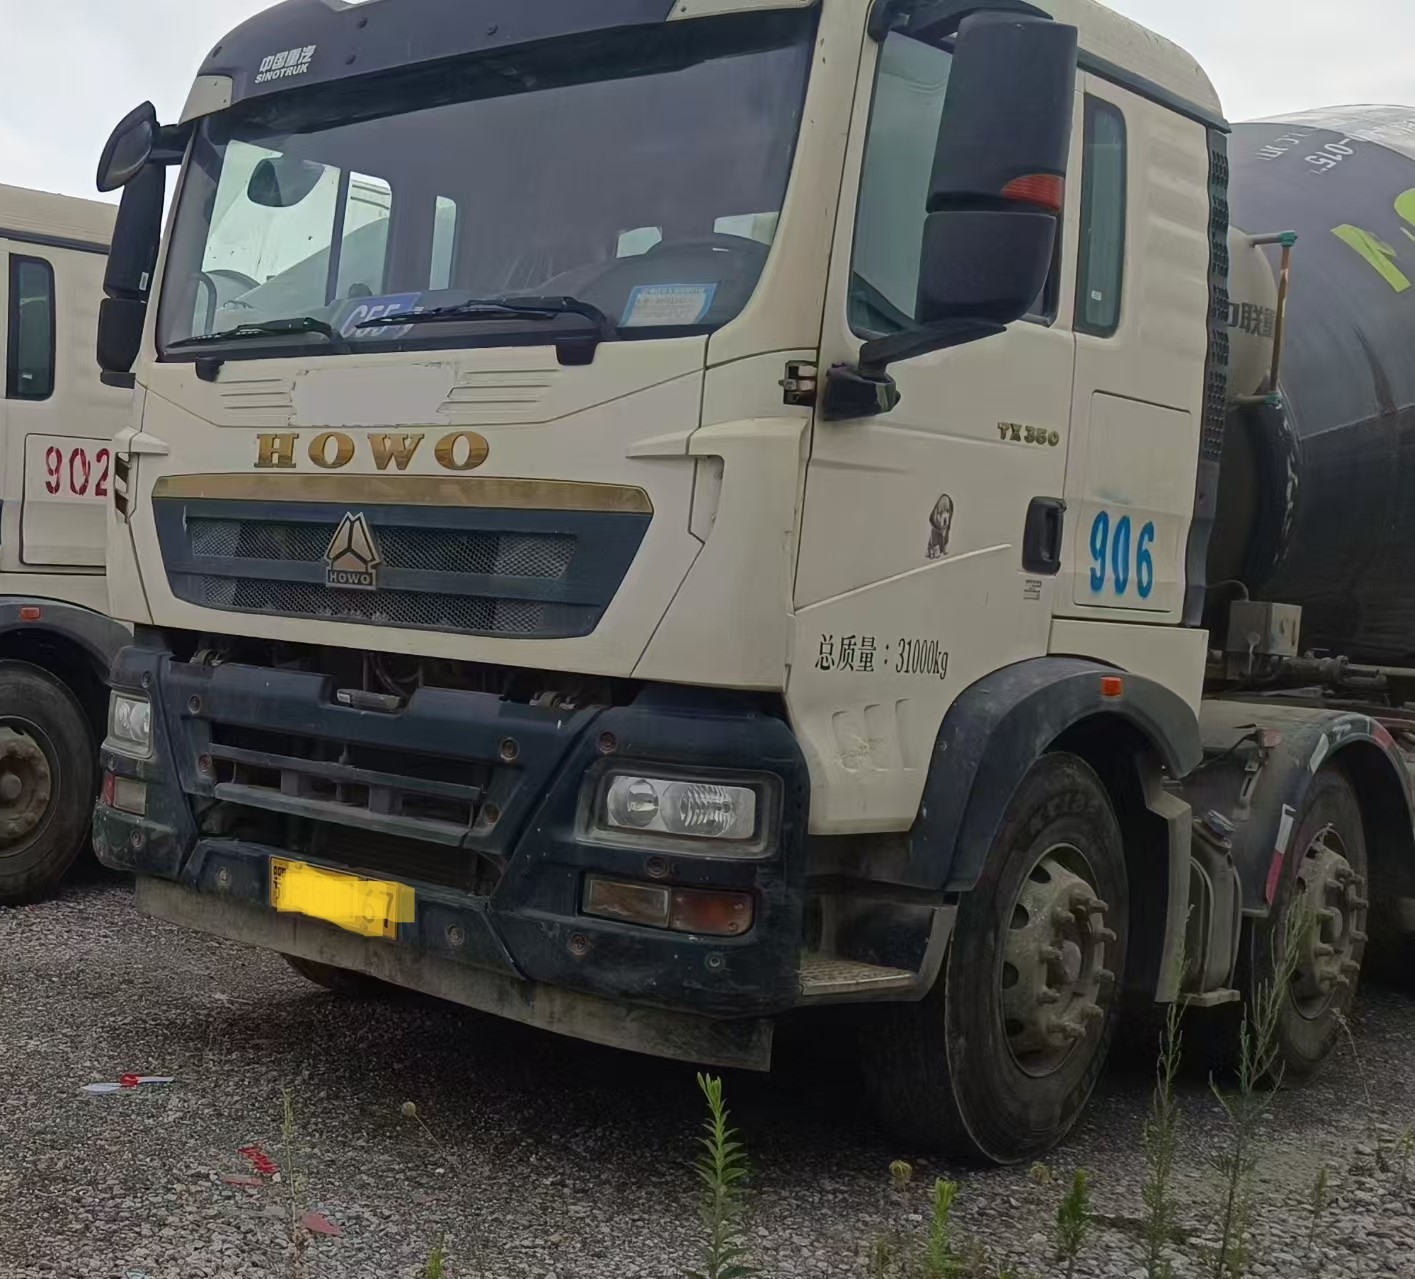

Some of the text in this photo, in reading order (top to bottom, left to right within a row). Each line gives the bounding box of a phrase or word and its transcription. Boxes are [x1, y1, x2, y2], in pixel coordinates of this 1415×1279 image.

[255, 63, 309, 84] SINOTRUK
[254, 431, 490, 470] HOWO
[45, 446, 110, 497] 902
[1089, 510, 1155, 598] 906
[329, 571, 371, 585] HOWO
